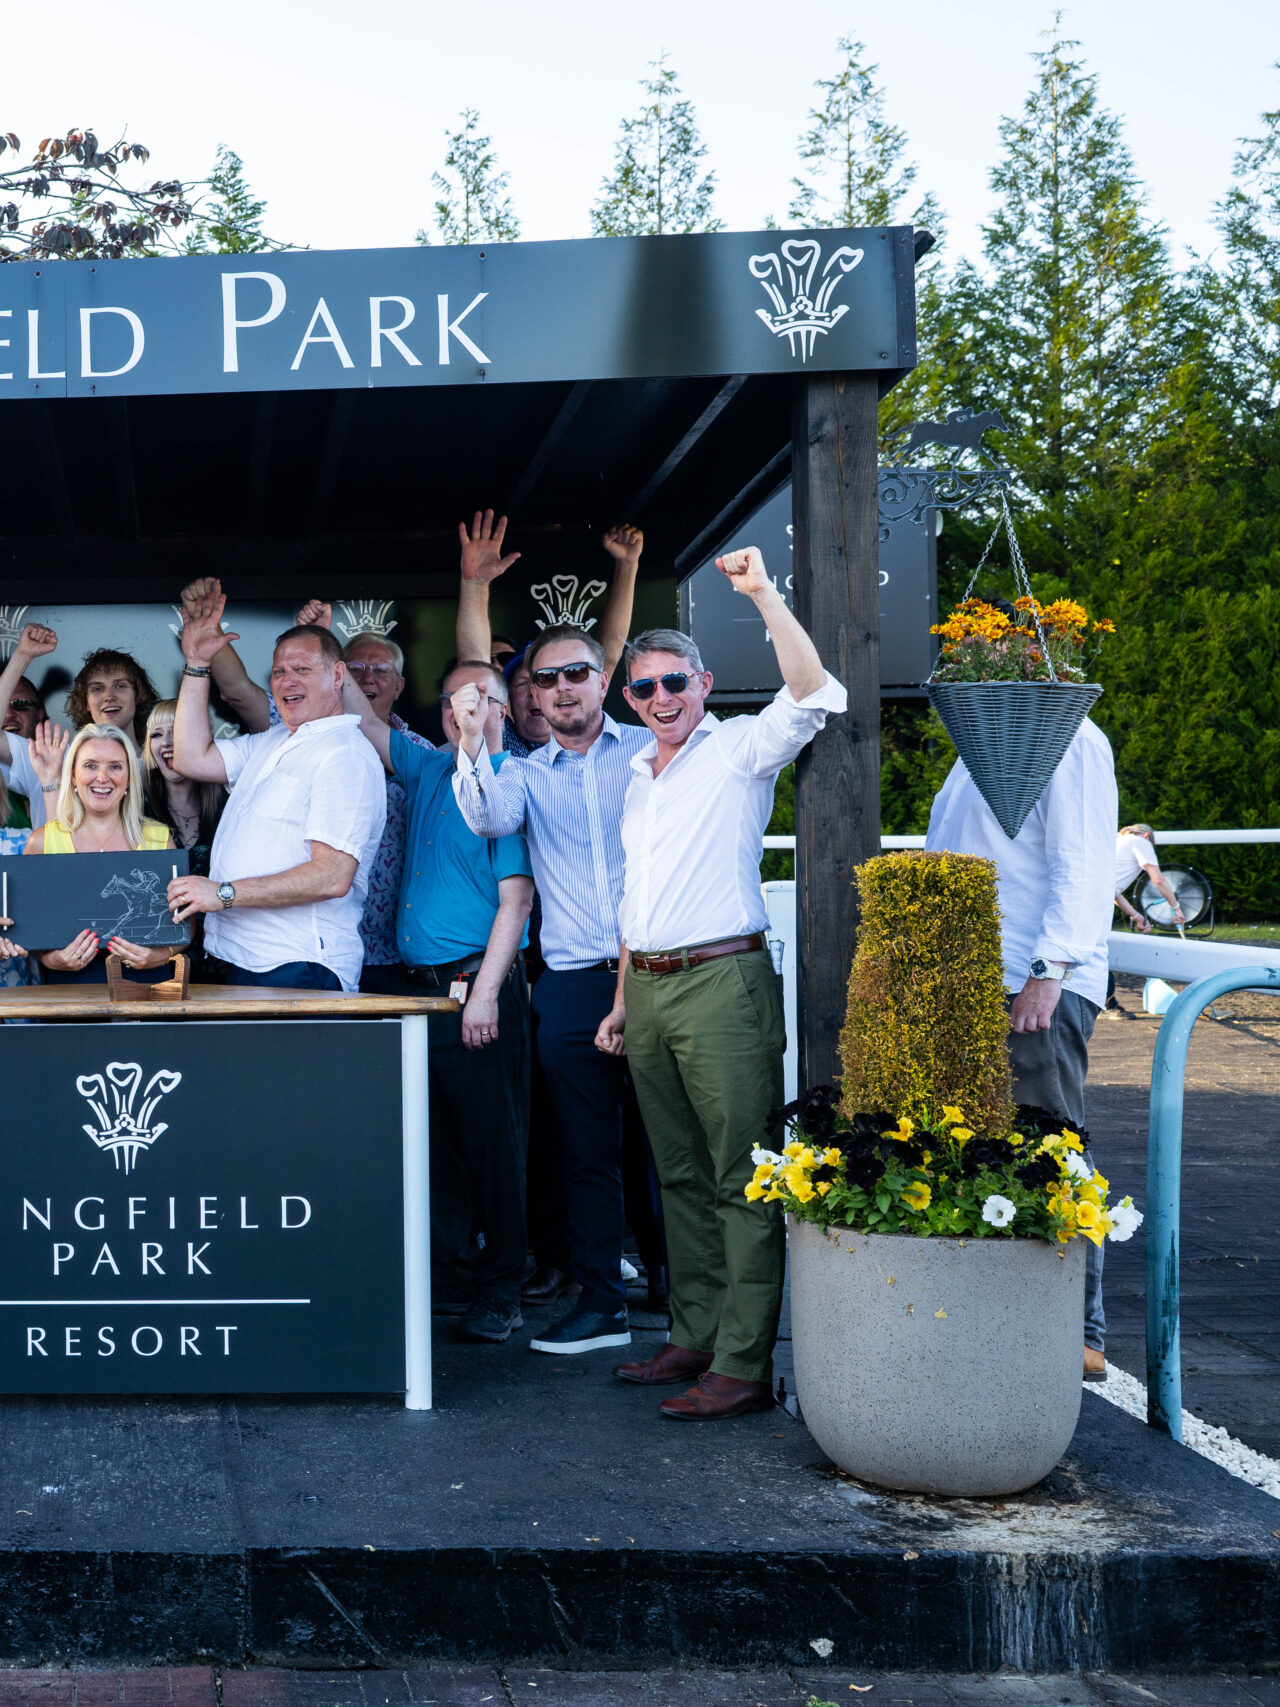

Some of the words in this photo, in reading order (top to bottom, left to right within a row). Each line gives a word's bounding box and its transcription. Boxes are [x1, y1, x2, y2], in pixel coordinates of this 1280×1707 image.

[221, 271, 491, 373] PARK
[53, 1242, 213, 1276] PARK
[27, 1326, 238, 1356] RESORT
